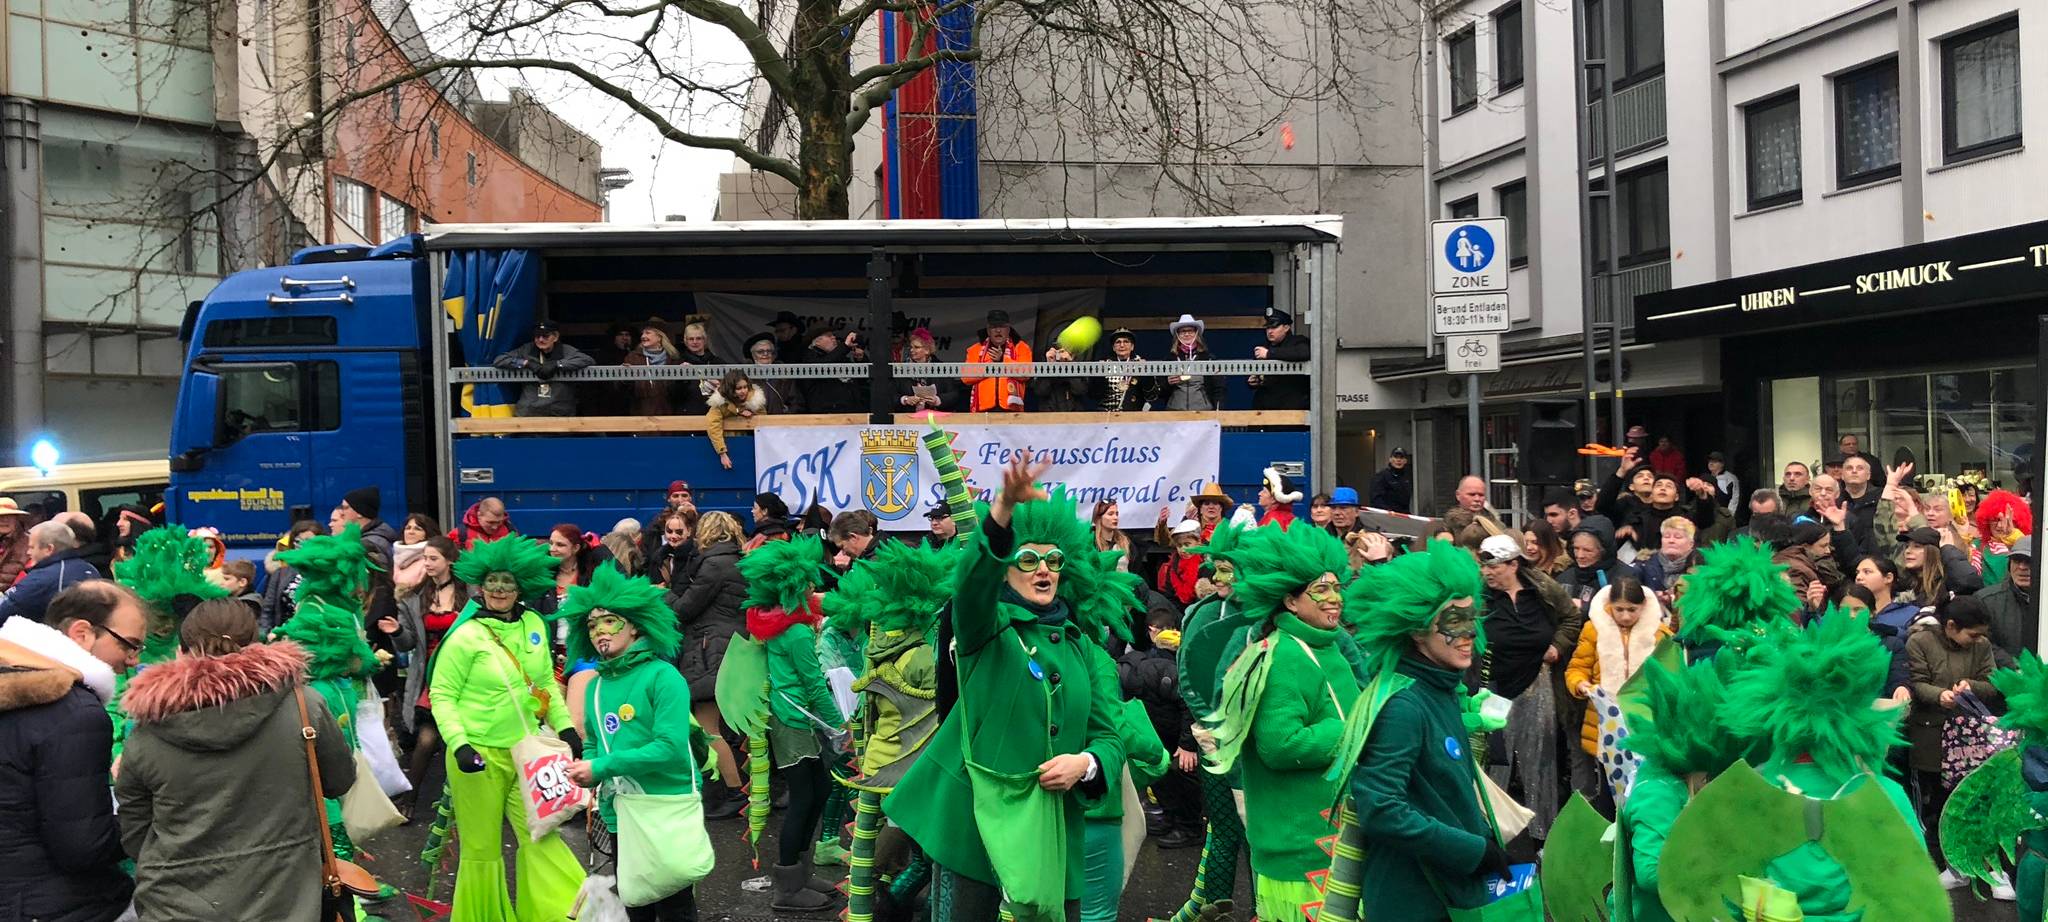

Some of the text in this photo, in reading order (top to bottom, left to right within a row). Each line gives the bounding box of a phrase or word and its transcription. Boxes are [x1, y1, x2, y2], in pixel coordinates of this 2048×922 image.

[1452, 275, 1489, 288] ZONE
[1741, 287, 1795, 311] UHREN
[1856, 261, 1953, 294] SCHMUCK
[1469, 302, 1506, 312] Entladen
[1487, 313, 1502, 323] frei
[1465, 360, 1481, 368] frei
[979, 437, 1161, 466] Festausschuss
